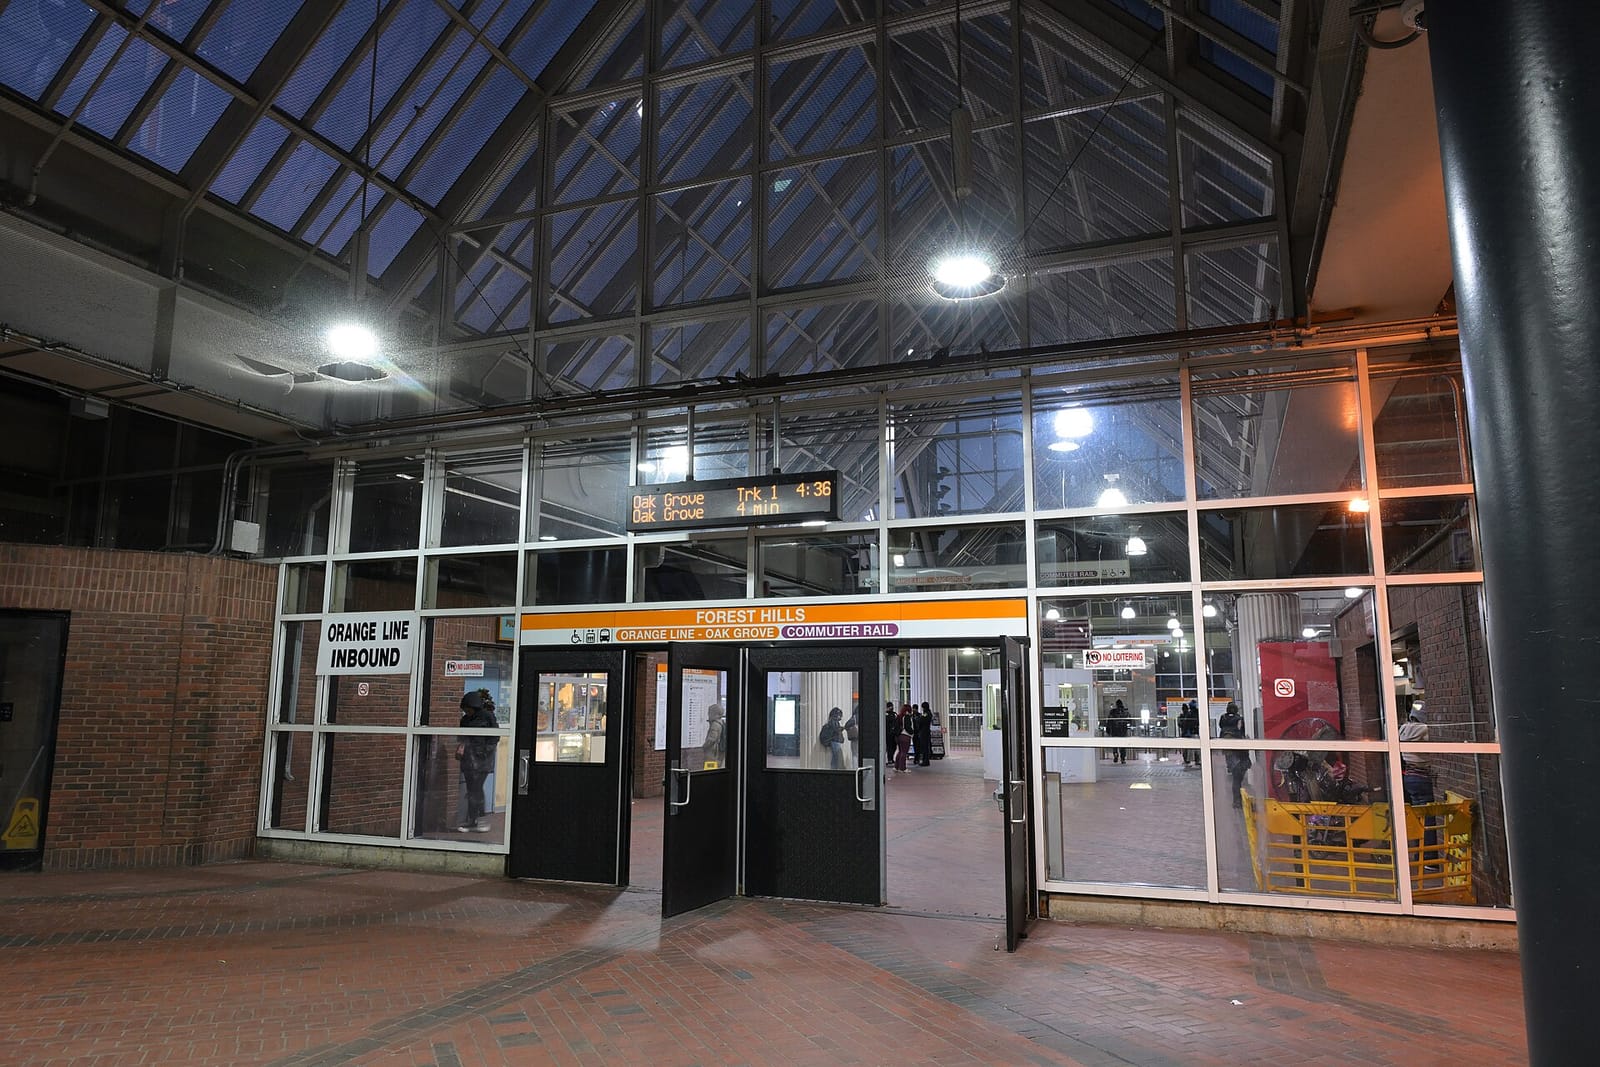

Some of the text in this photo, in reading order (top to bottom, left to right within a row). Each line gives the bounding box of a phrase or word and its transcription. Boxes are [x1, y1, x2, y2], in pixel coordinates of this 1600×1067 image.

[633, 480, 832, 509] Oak Grove Trk 1 4:36
[632, 500, 780, 523] Oak Grove 4 min
[696, 608, 806, 624] FOREST HILLS
[327, 620, 410, 642] ORANGE LINE
[620, 629, 667, 640] ORANGE
[670, 629, 695, 639] LINE
[705, 628, 730, 639] OAK
[733, 627, 775, 638] GROVE
[786, 625, 893, 637] COMMUTER RAIL
[330, 647, 400, 668] INBOUND
[1102, 653, 1143, 662] NO LOITERING
